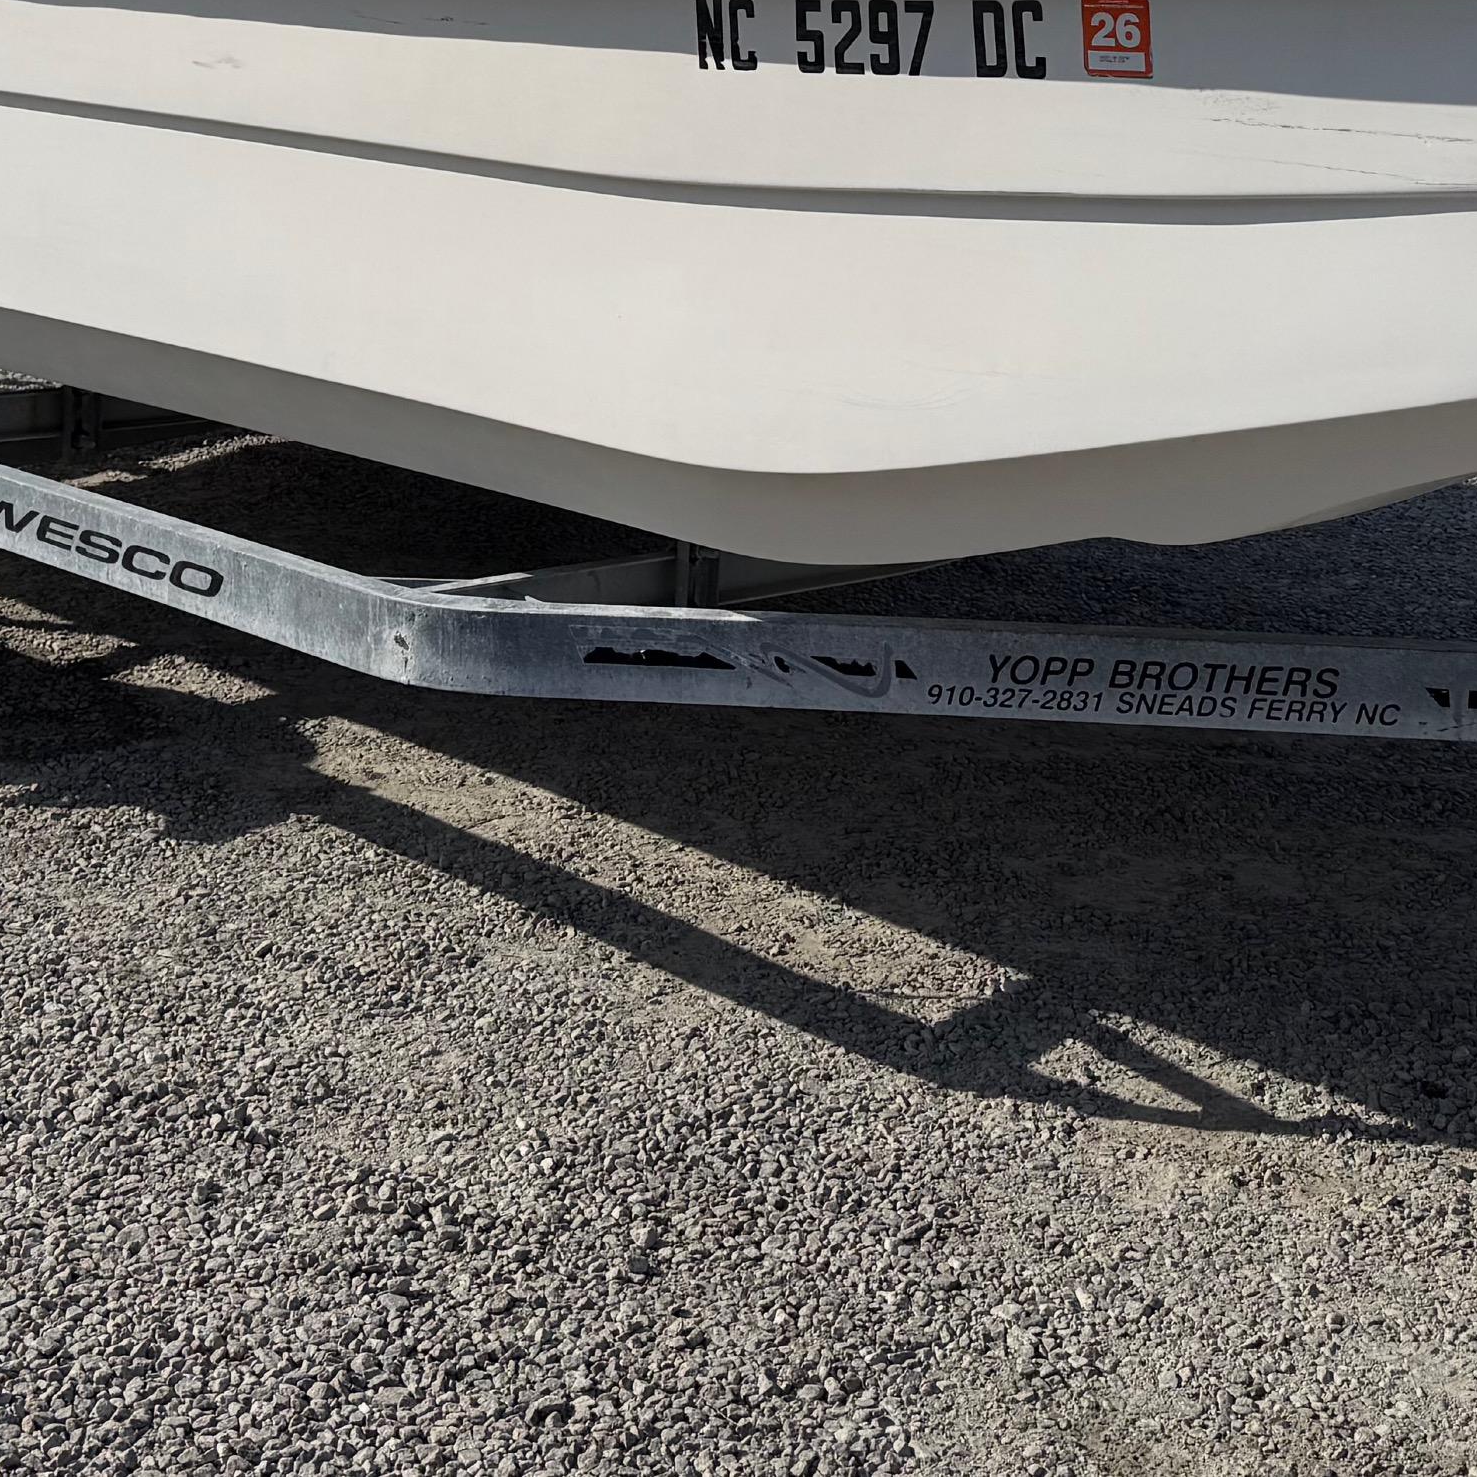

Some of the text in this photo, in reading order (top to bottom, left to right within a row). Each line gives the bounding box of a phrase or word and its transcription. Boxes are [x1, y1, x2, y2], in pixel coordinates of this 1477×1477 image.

[972, 0, 1047, 80] DC
[1090, 10, 1142, 49] 26
[988, 653, 1341, 700] YOPP BROTHERS
[926, 683, 1402, 727] 910-327-2831 SNEADS FERRY NC
